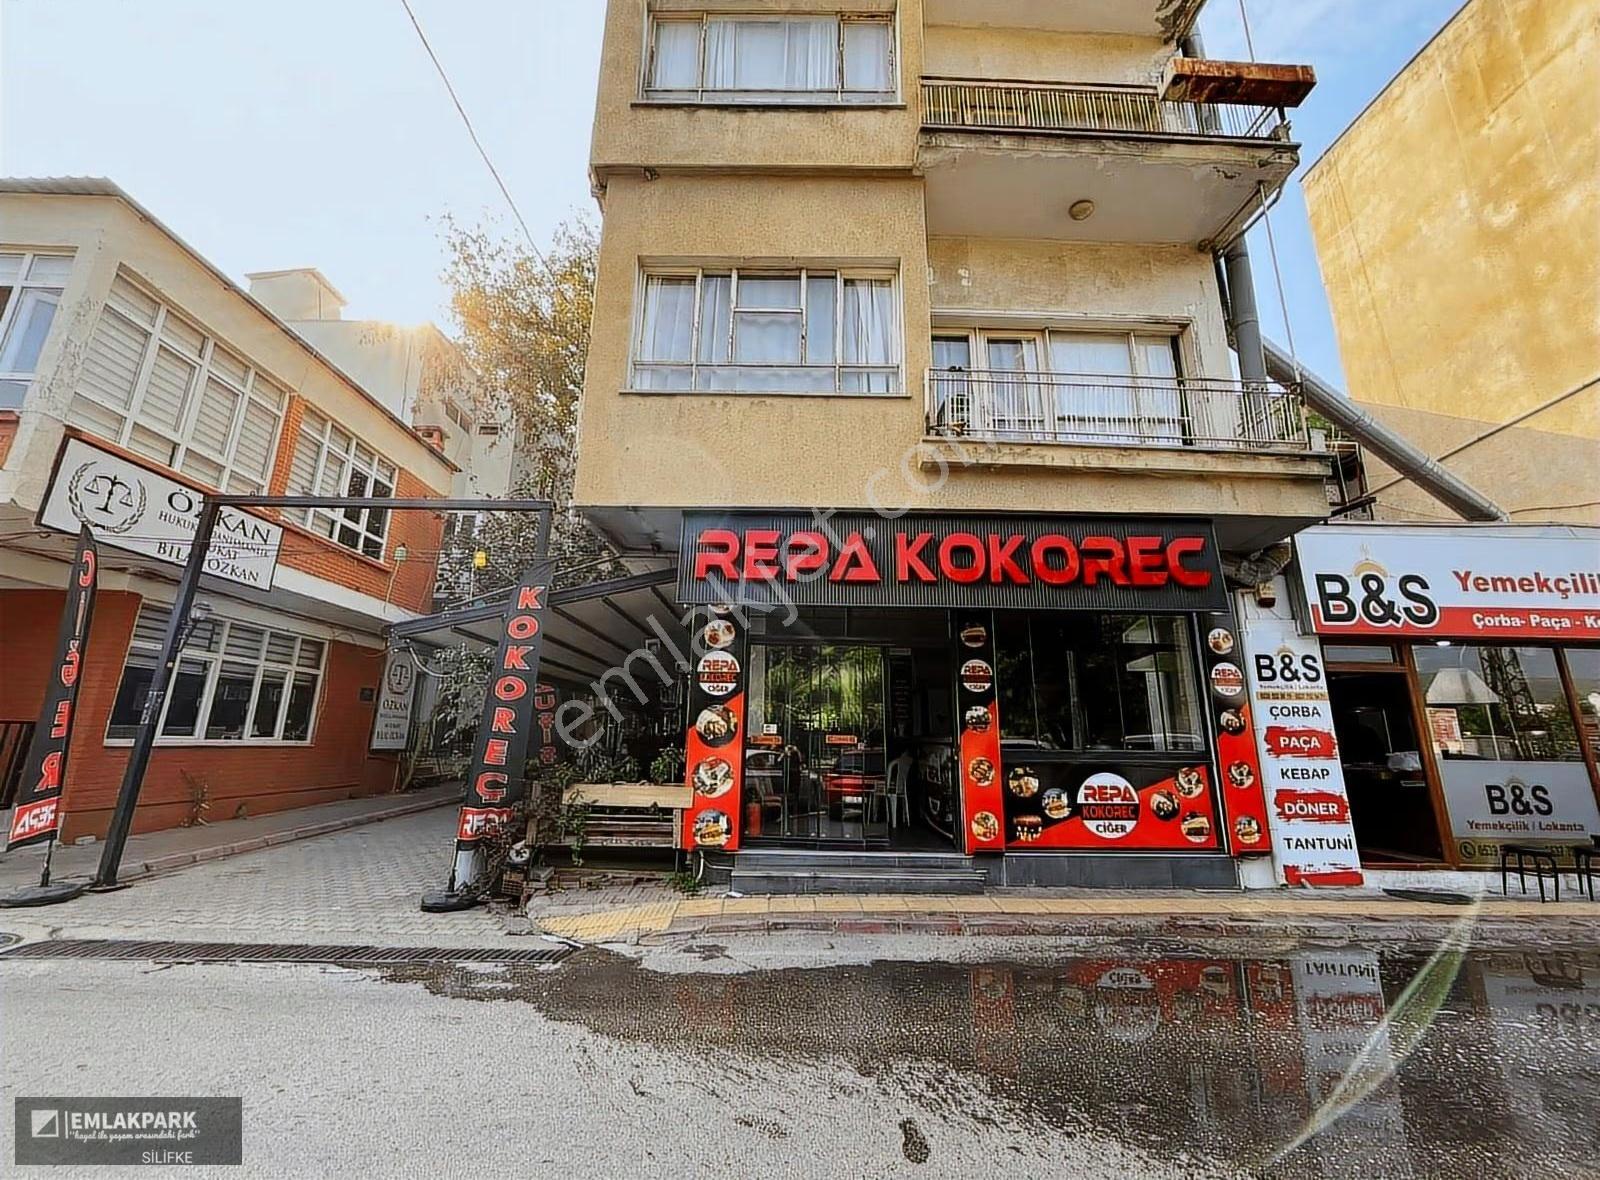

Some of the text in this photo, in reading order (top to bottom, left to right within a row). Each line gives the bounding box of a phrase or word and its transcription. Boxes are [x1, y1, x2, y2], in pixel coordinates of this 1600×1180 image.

[695, 528, 1213, 588] REPA KOKOREC
[1452, 570, 1600, 599] Yemekçili
[1314, 573, 1438, 625] B&S
[1529, 614, 1572, 630] Paça
[703, 659, 738, 671] REPA
[1254, 654, 1321, 682] B&S
[1269, 706, 1321, 720] ÇORBA
[1279, 736, 1321, 752] PAÇA
[1280, 768, 1330, 780] KEBAP
[1083, 785, 1137, 802] REPA
[1485, 785, 1553, 815] B&S
[1082, 805, 1136, 819] KOKOREC
[1284, 799, 1340, 815] DÖNER
[1466, 820, 1585, 832] Yemekçilik Lokanta
[1283, 833, 1353, 850] TANTUNİ
